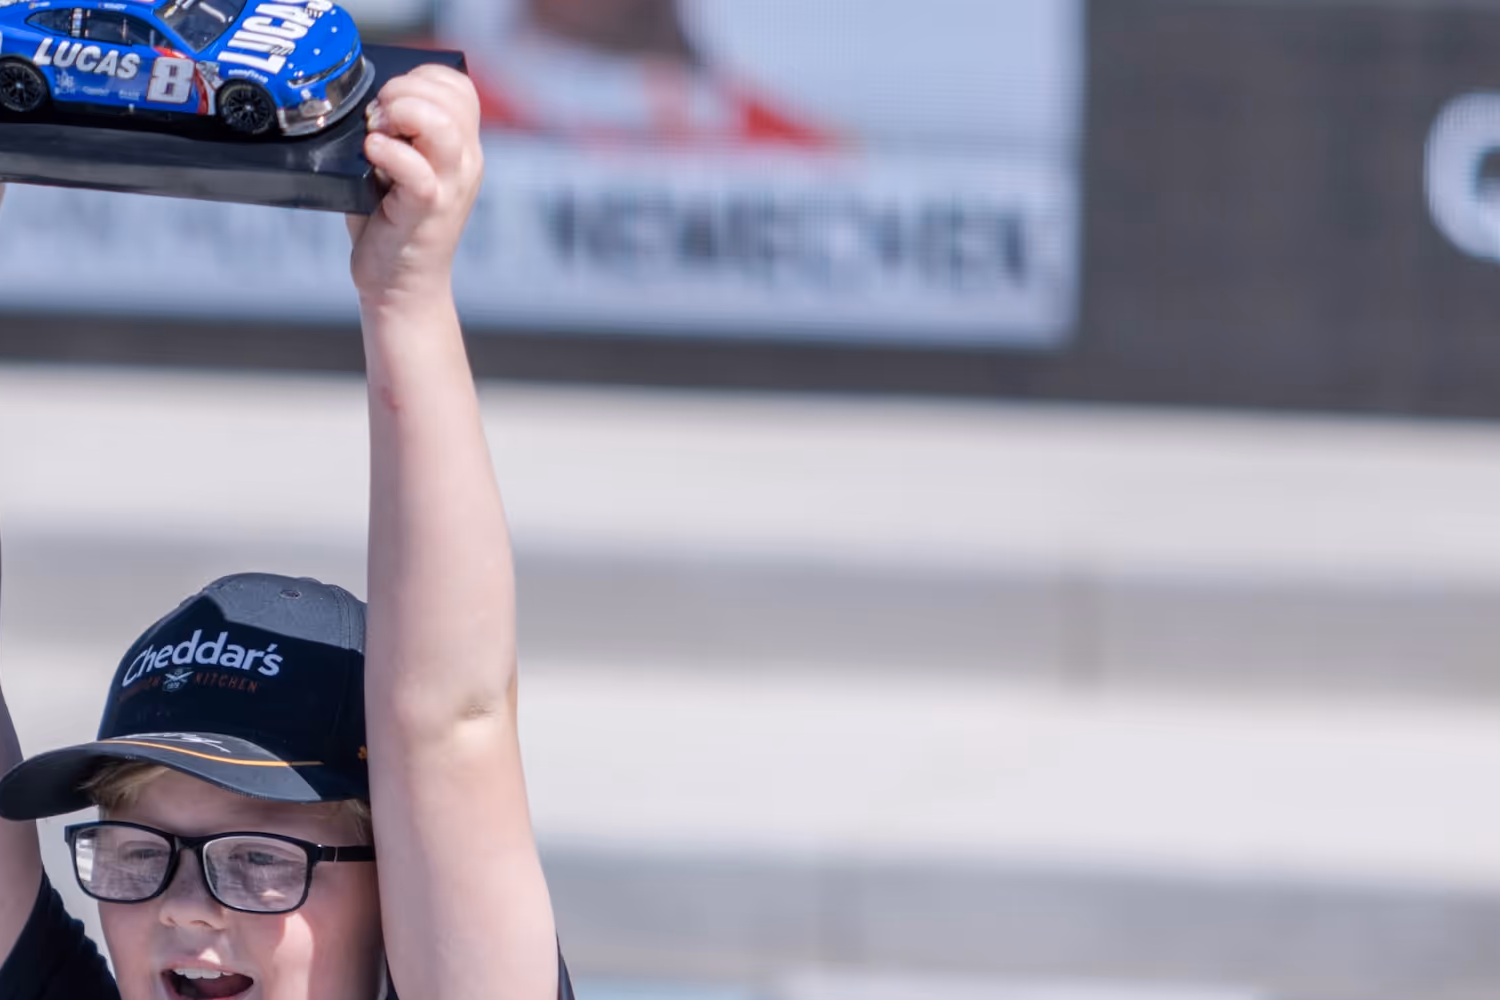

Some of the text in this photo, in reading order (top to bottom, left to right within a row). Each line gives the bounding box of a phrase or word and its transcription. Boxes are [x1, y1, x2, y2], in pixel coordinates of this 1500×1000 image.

[33, 37, 195, 104] LUCAS 8
[121, 629, 284, 688] Cheddar's
